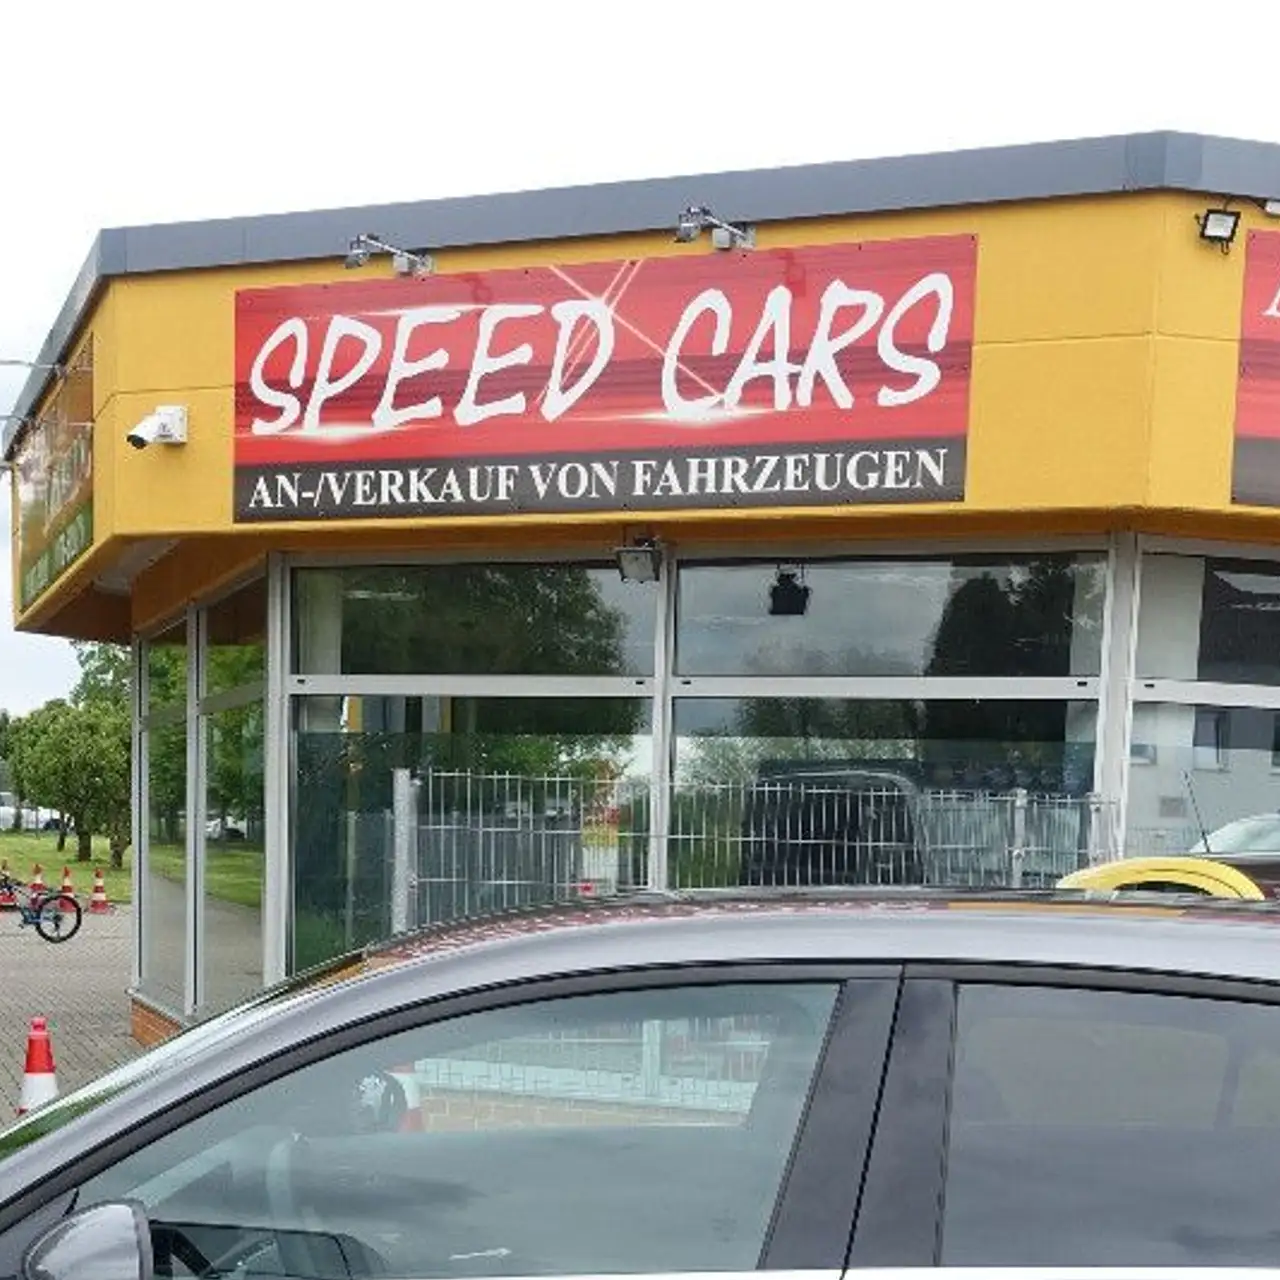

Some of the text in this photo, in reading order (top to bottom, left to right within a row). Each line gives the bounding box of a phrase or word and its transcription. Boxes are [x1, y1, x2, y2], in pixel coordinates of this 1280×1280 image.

[249, 271, 955, 435] SPEED CARS
[530, 459, 621, 500] VON
[631, 447, 950, 498] FAHRZEUGEN
